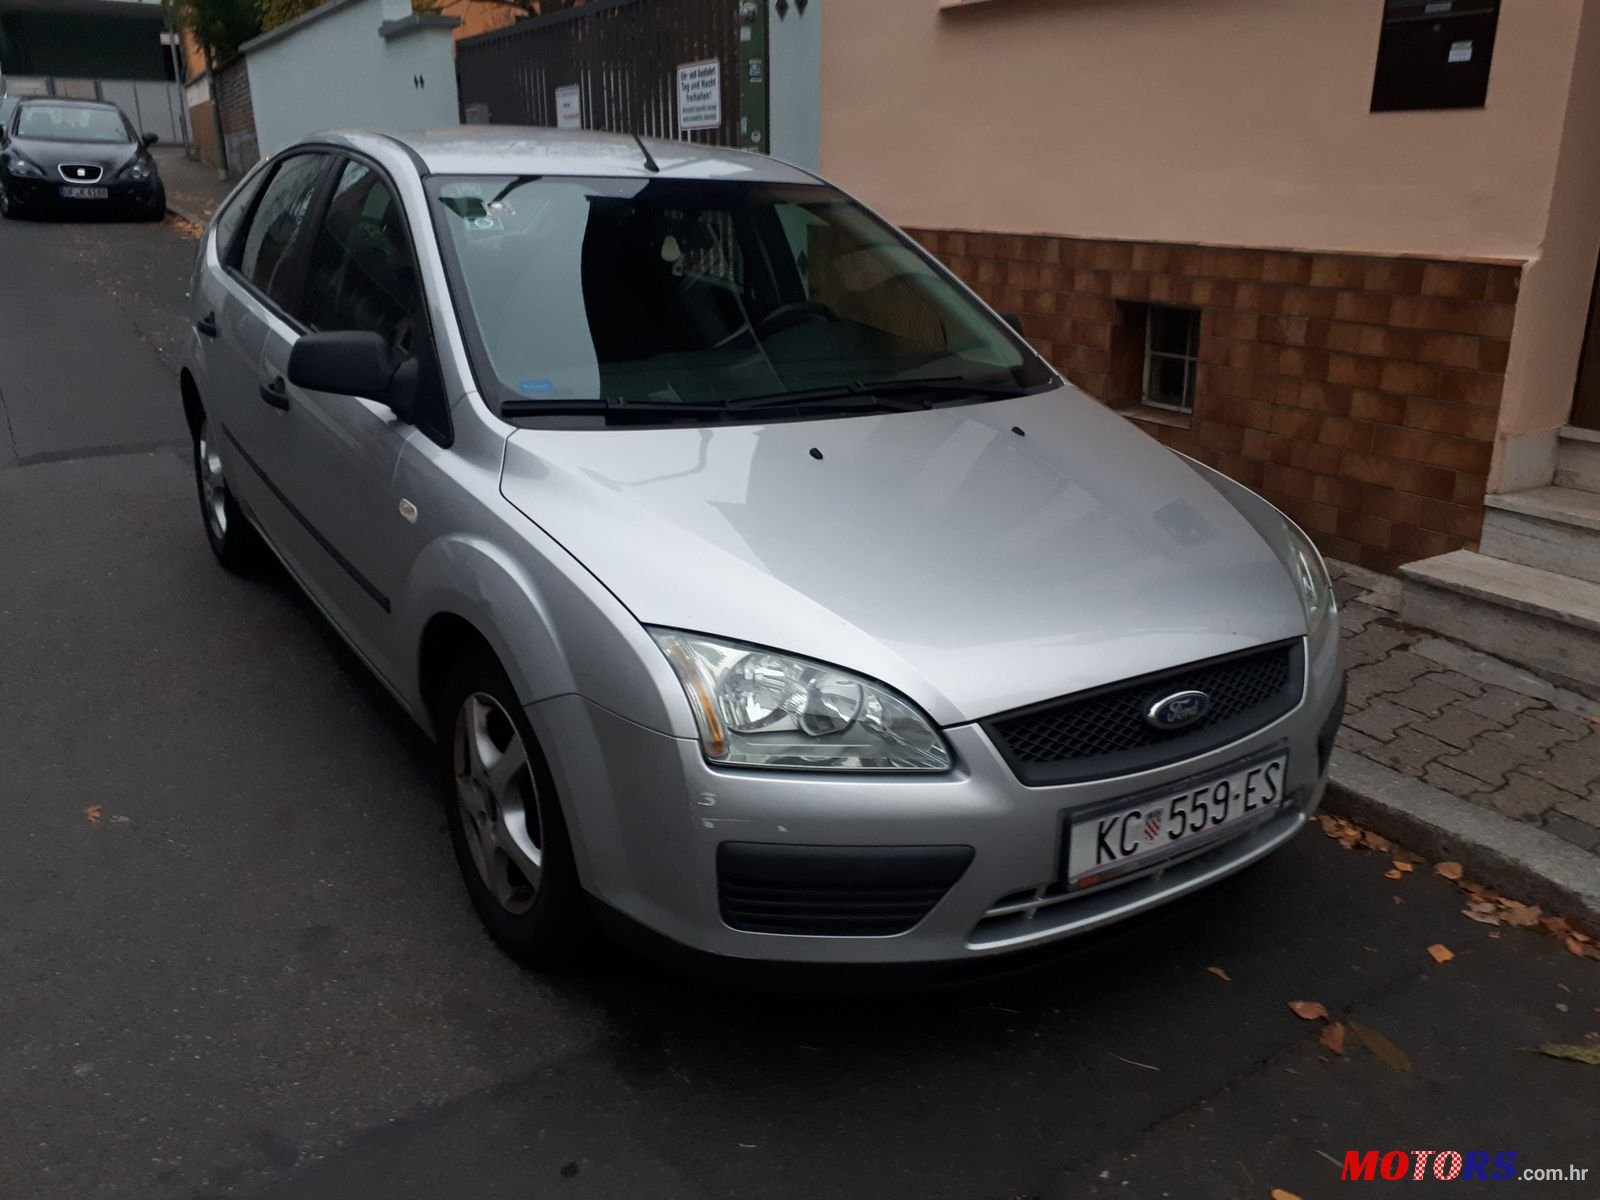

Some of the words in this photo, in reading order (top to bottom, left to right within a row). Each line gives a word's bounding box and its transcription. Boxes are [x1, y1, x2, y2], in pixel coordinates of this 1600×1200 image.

[681, 82, 690, 93] Tag
[691, 80, 700, 90] und
[701, 78, 716, 88] Nacht
[1167, 699, 1199, 722] Ford
[1096, 811, 1142, 865] KC
[1168, 761, 1280, 840] 559-ES
